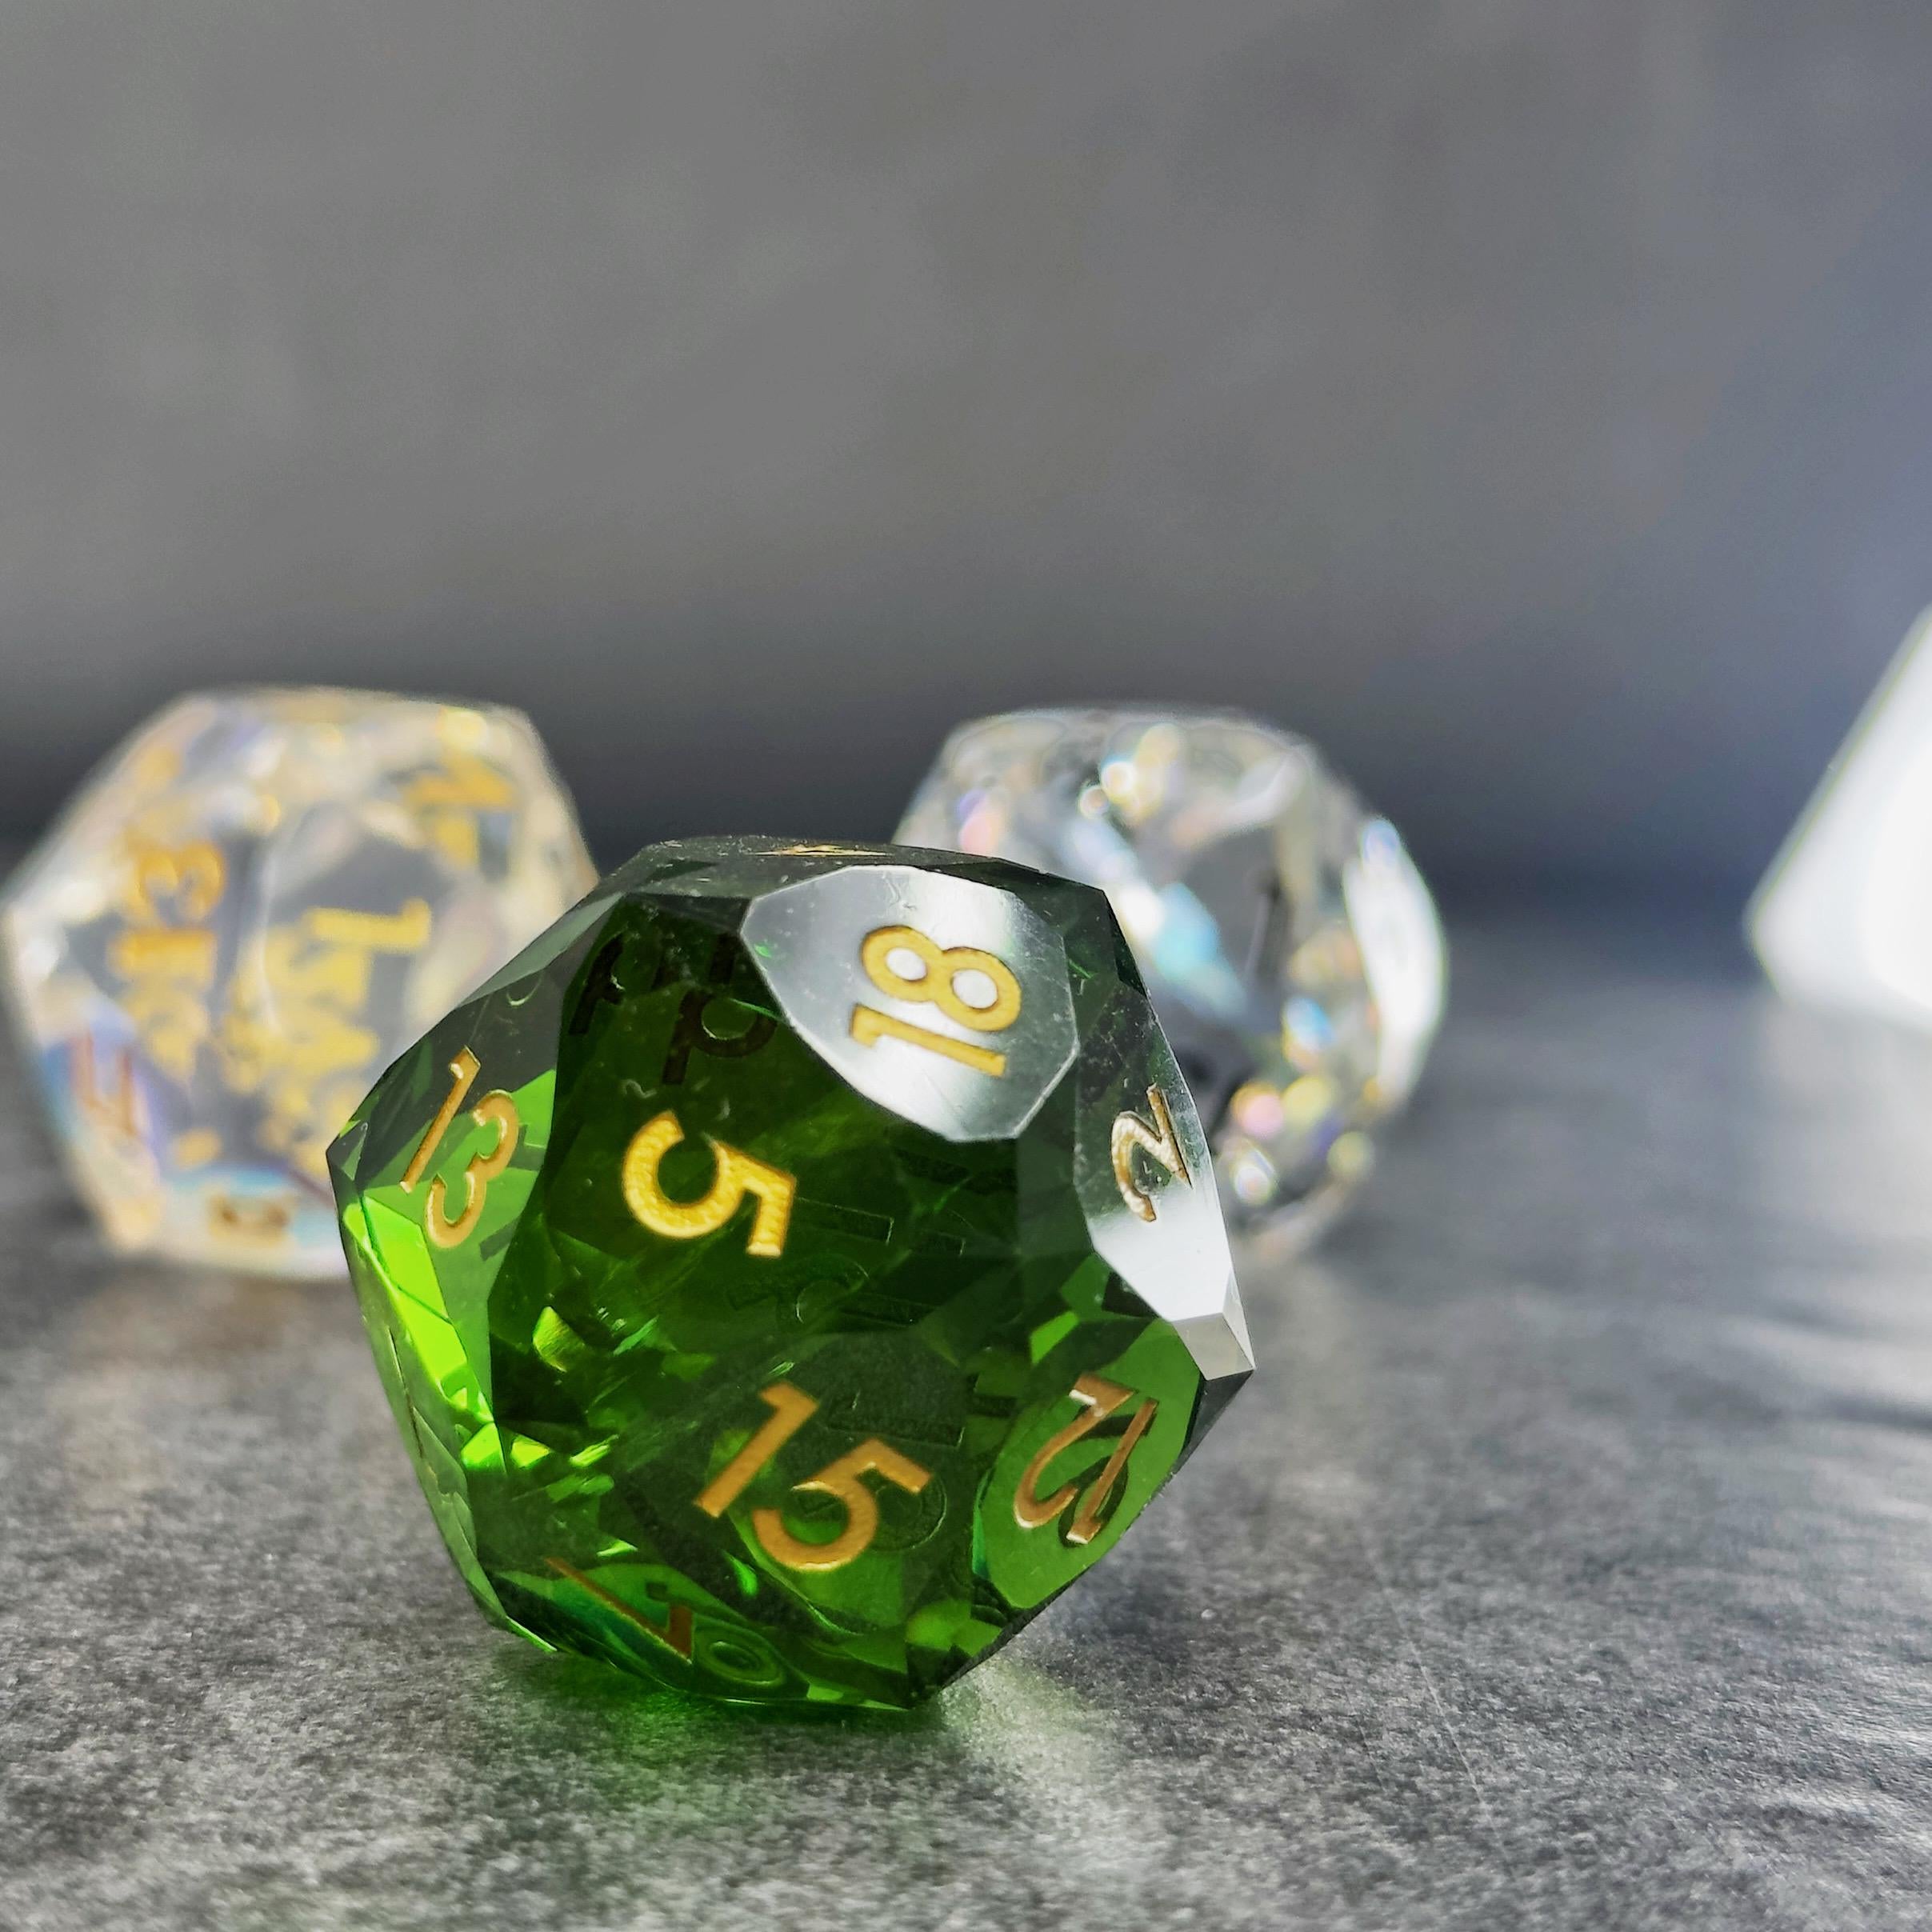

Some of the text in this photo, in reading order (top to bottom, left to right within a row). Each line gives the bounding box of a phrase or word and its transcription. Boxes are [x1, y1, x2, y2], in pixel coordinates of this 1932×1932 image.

[850, 925, 1022, 1077] 18
[399, 1046, 519, 1249] 13
[622, 1110, 797, 1258] 5
[1111, 1083, 1194, 1222] 2
[694, 1381, 934, 1573] 15
[1013, 1372, 1160, 1546] 12
